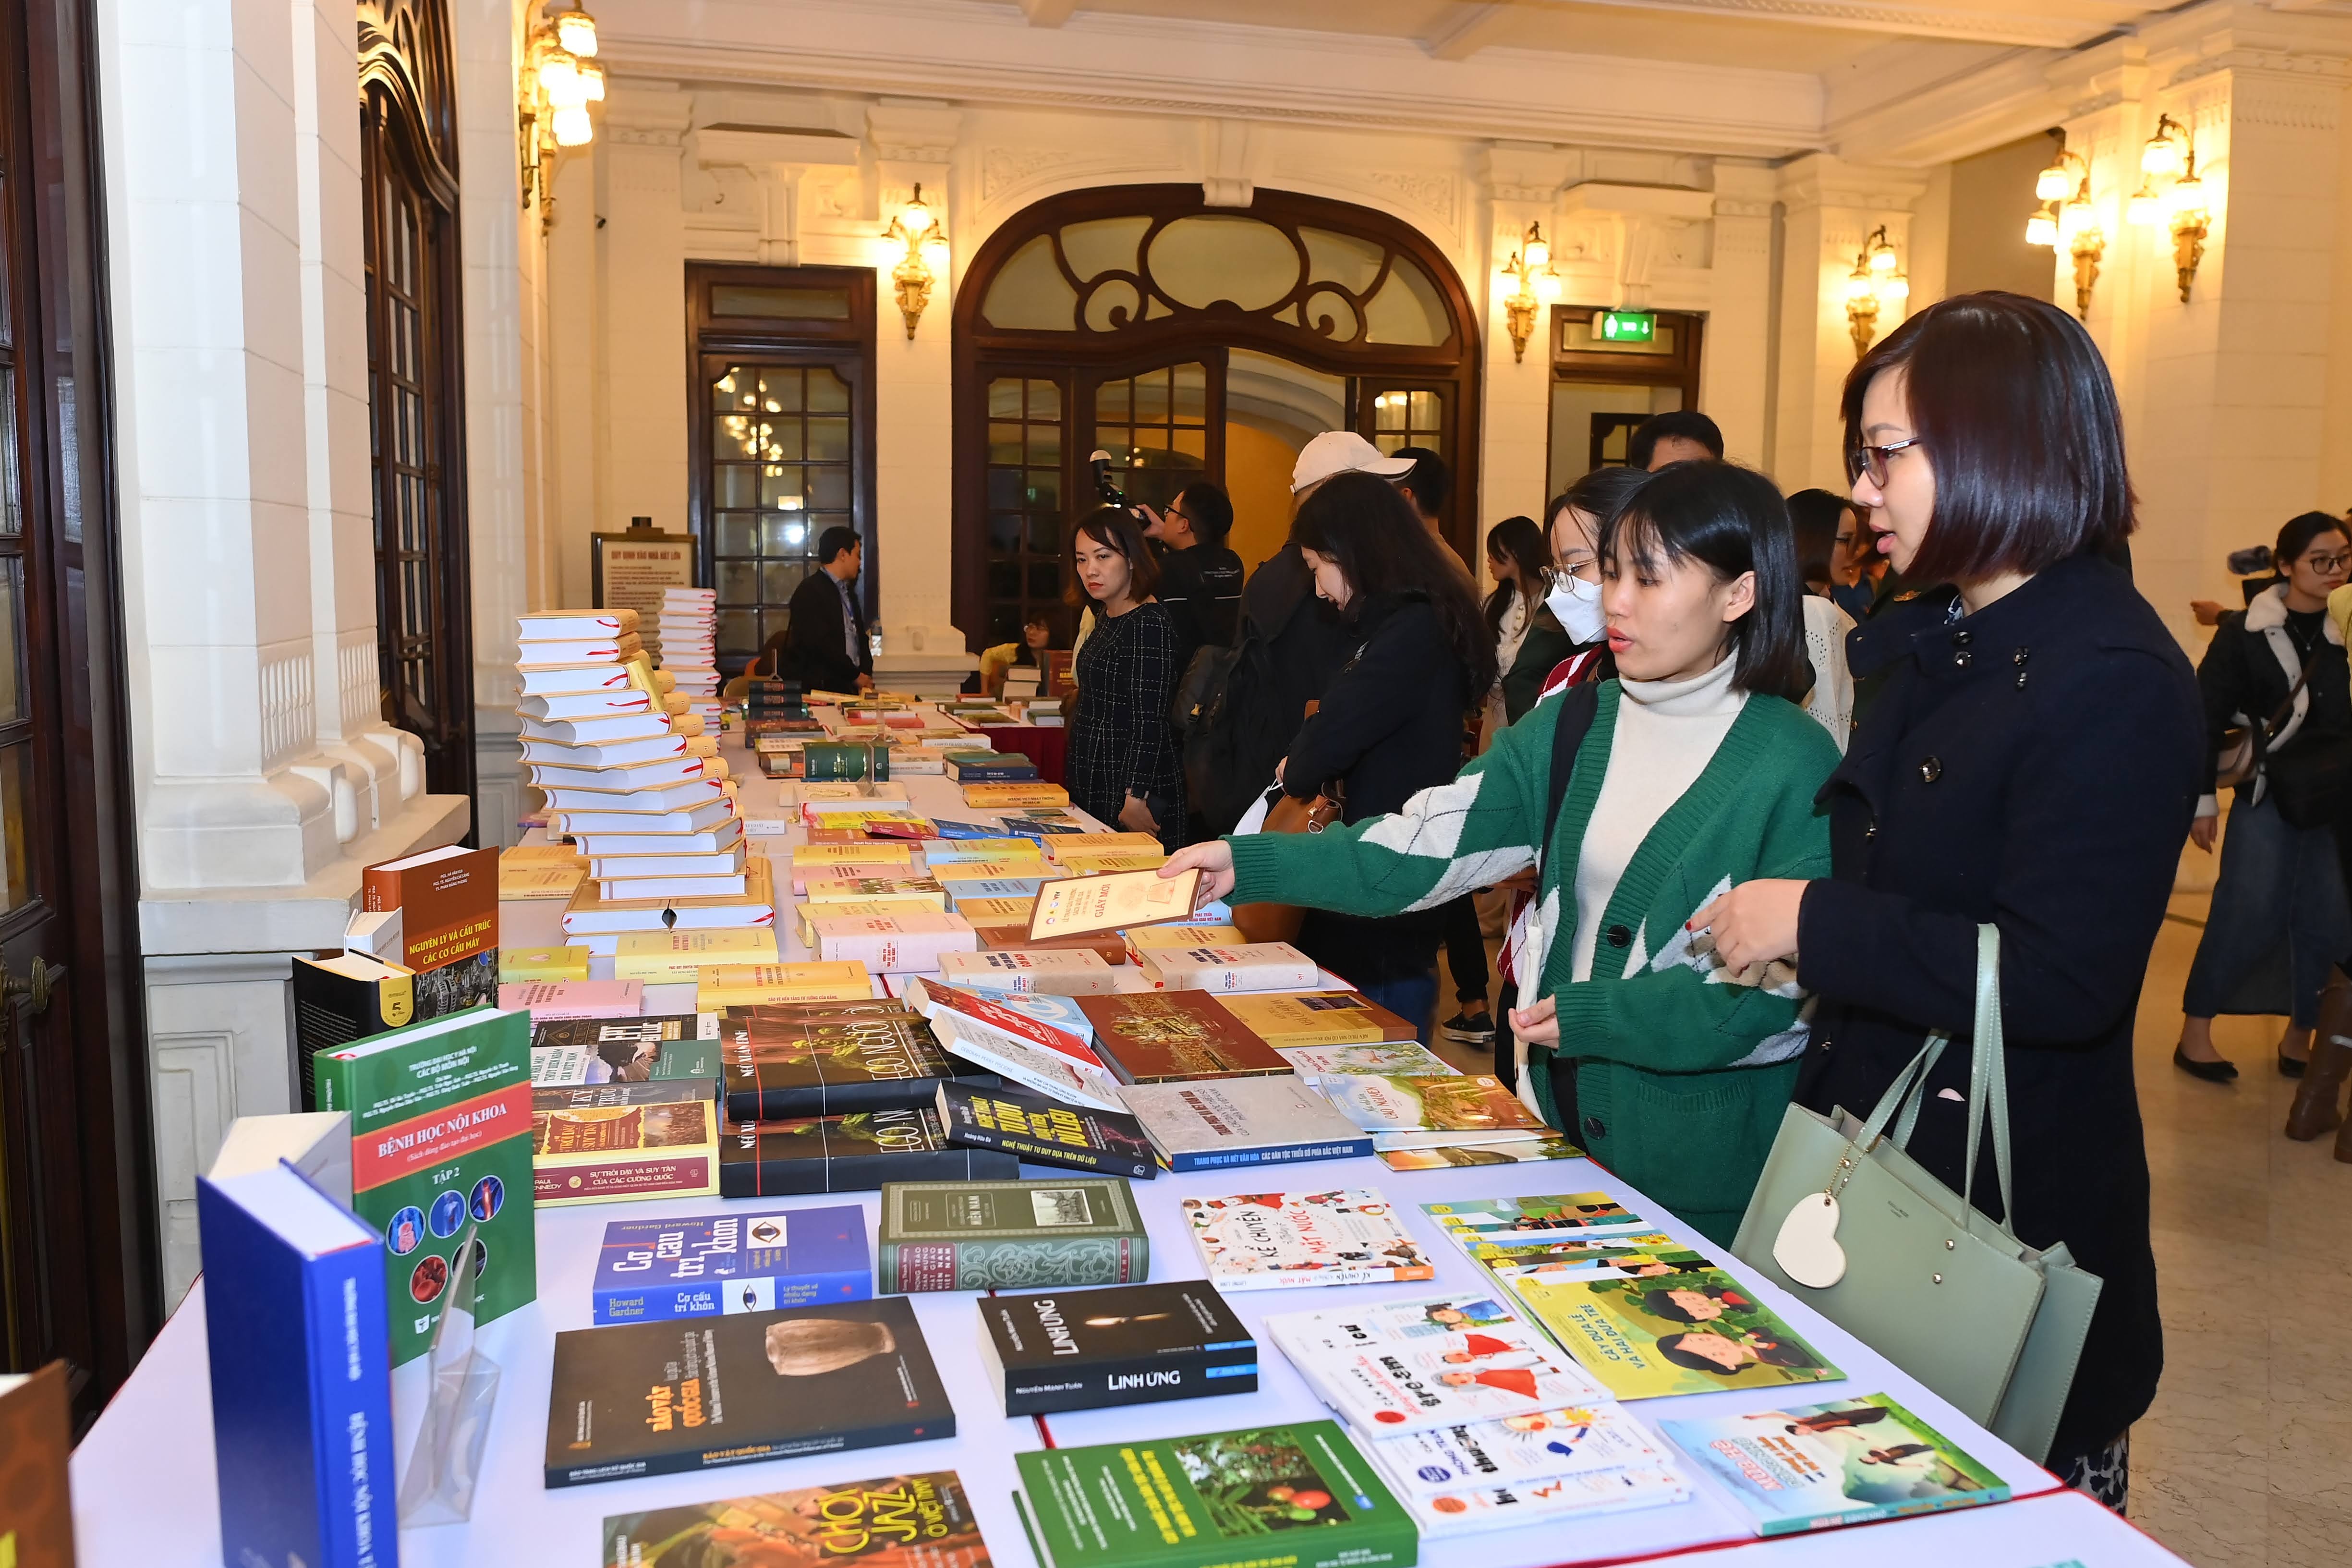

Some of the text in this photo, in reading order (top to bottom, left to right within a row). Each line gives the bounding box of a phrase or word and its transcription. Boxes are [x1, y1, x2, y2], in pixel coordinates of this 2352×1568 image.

[440, 932, 447, 945] LÝ
[449, 930, 458, 942] VÀ
[475, 919, 491, 933] TRÚC
[423, 952, 437, 965] CÁC
[438, 948, 449, 958] CƠ
[466, 937, 480, 950] MÁY
[378, 1103, 507, 1158] BỆNH HỌC NỘI KHOA
[1001, 1139, 1016, 1149] NGHỆ
[1017, 1142, 1033, 1153] THUẬT
[1034, 1145, 1041, 1154] TƯ
[1041, 1147, 1051, 1156] DUY
[1052, 1150, 1063, 1159] DỰA
[1063, 1151, 1077, 1160] TRÊN
[1086, 1155, 1097, 1165] LIỆU
[432, 1167, 460, 1185] TẬP 2
[593, 1177, 608, 1185] CỦA
[610, 1176, 625, 1185] CÁC
[654, 1173, 674, 1181] QUỐC
[609, 1297, 644, 1308] Howard
[677, 1291, 711, 1303] Cơ cấu
[609, 1306, 645, 1318] Gardner
[674, 1300, 715, 1313] trí khôn
[1598, 1344, 1621, 1361] CÂY
[1612, 1338, 1634, 1354] HAI
[1108, 1370, 1181, 1391] LINH ỨNG
[817, 1488, 869, 1554] CHƠI
[862, 1485, 917, 1543] JAZZ
